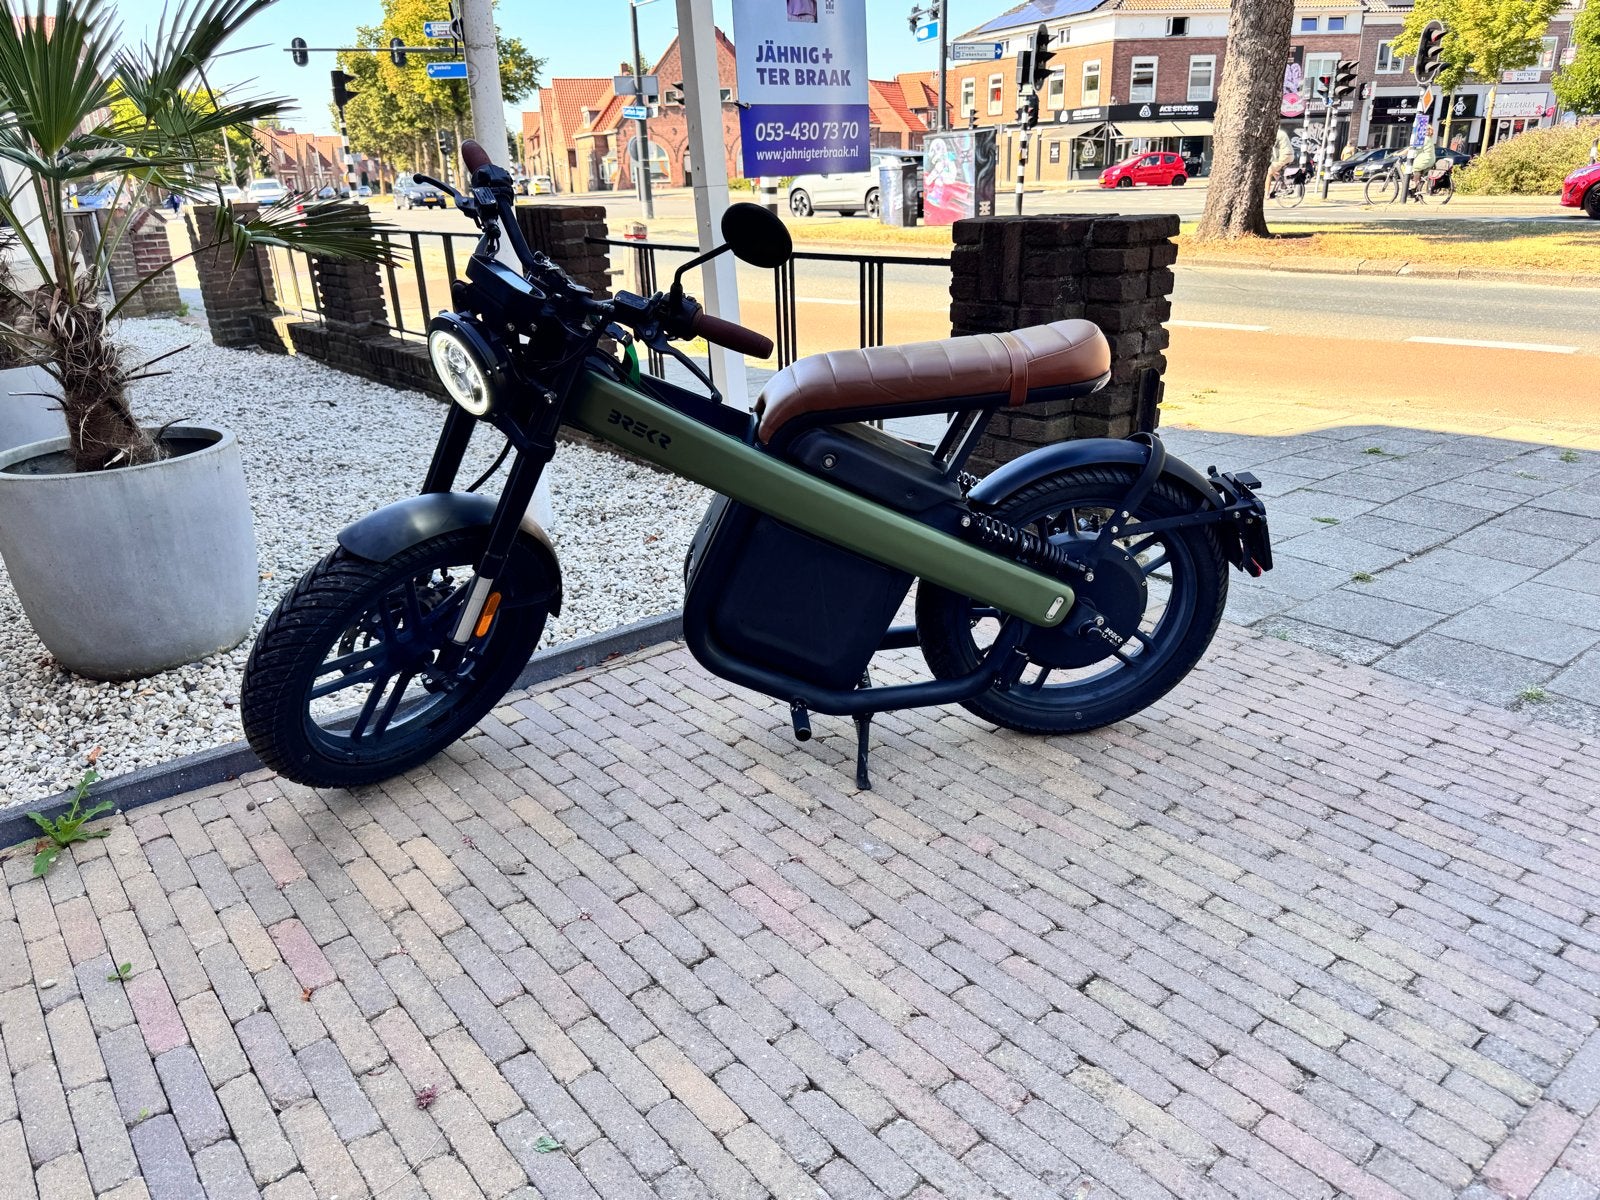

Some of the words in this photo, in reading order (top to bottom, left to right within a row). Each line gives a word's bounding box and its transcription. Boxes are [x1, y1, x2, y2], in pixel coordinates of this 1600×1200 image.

[756, 40, 819, 64] JÄHNIG
[822, 48, 833, 64] +
[756, 68, 790, 85] TER
[795, 69, 851, 86] BRAAK
[755, 121, 820, 141] 053-430
[823, 122, 838, 139] 73
[842, 121, 859, 139] 70
[756, 144, 859, 162] www.jahnigterbraak.nl
[607, 408, 672, 450] BREKR
